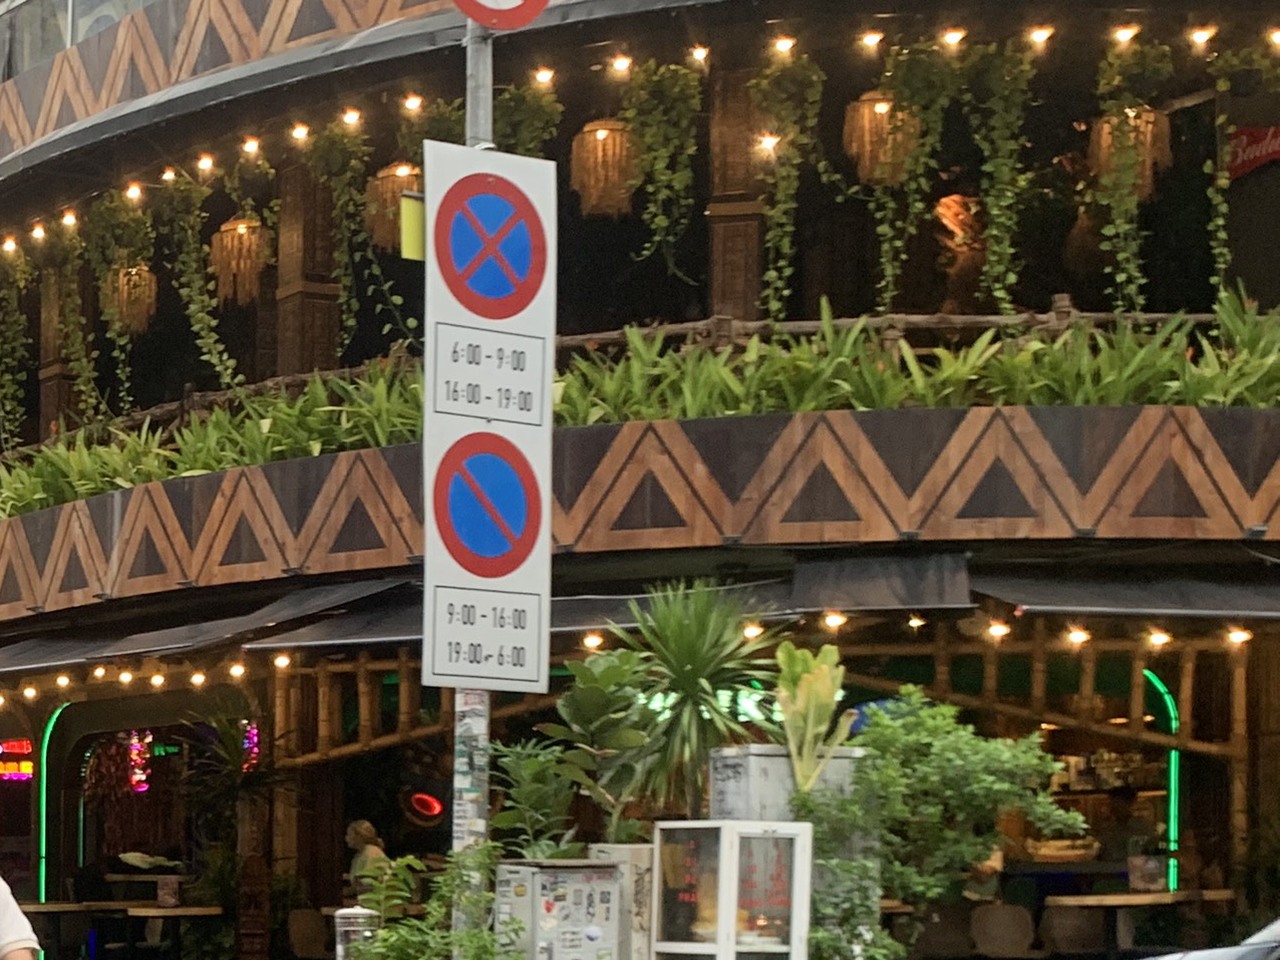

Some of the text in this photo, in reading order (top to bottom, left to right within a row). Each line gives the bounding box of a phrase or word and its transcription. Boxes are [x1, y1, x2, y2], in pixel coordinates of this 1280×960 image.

[452, 341, 481, 366] 6:00
[496, 347, 526, 372] 9:00
[445, 380, 481, 405] 16:00
[497, 388, 533, 412] 19:00
[447, 603, 477, 626] 9:00
[491, 606, 527, 630] 16:00
[448, 641, 483, 664] 19:00
[497, 645, 526, 667] 6:00
